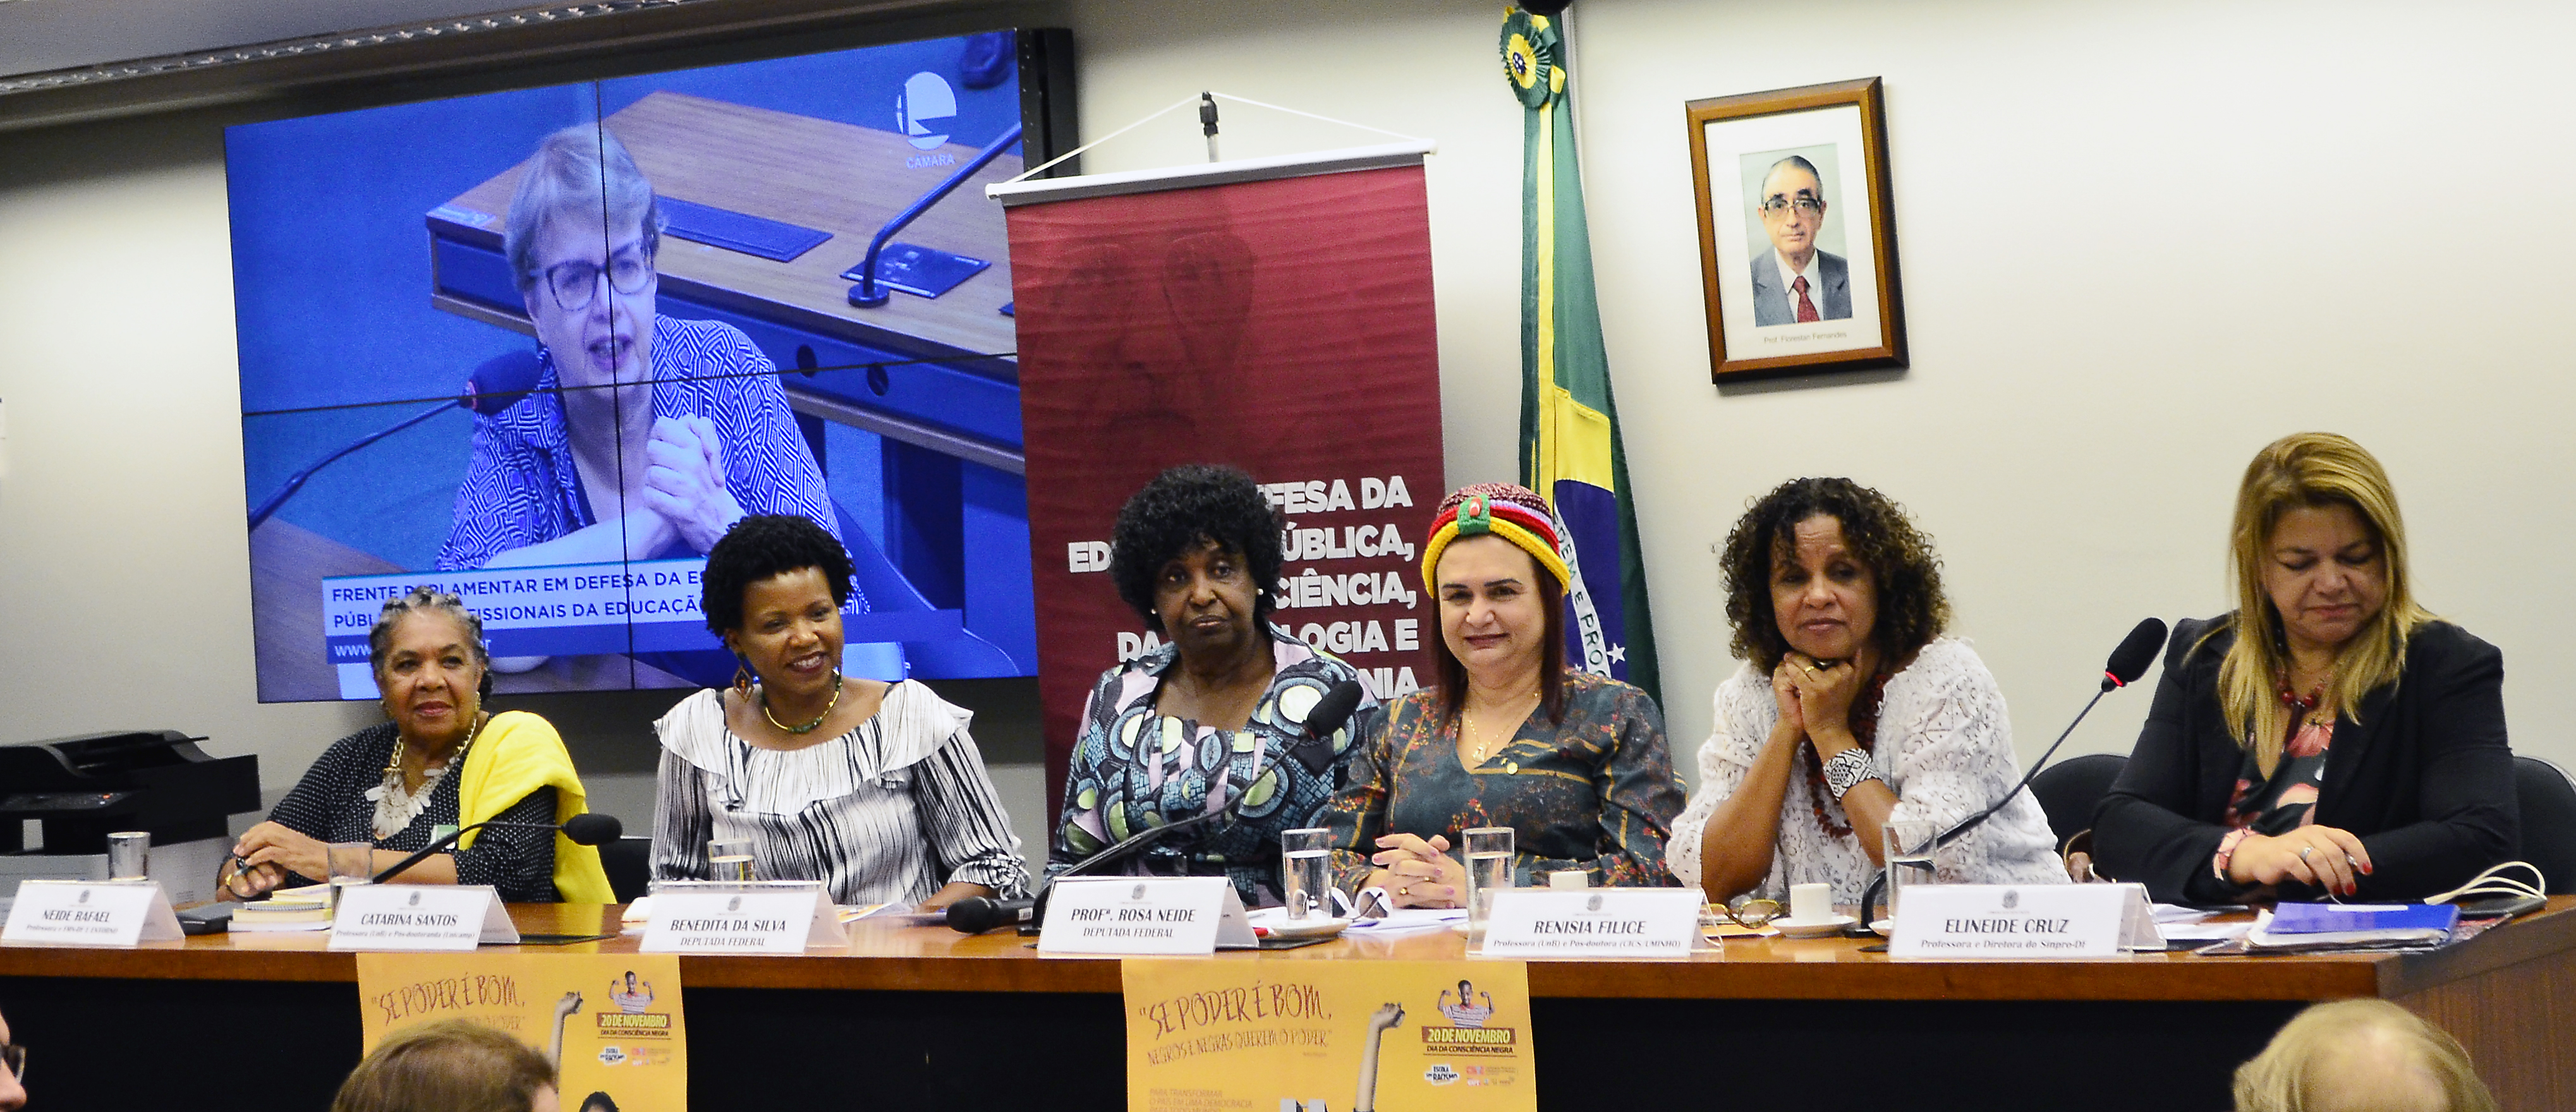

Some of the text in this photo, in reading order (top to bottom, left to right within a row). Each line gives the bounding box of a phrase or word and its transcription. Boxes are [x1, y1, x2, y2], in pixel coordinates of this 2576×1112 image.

[1256, 476, 1413, 514] FESA DA
[1281, 521, 1414, 562] ÚBLICA,
[333, 586, 398, 601] FRENTE
[544, 577, 569, 591] EM
[574, 574, 648, 589] DEFESA
[655, 572, 681, 586] DA
[1273, 568, 1417, 609] CIÊNCIA,
[334, 595, 704, 627] PÚBL ISSIONAIS DA EDUCAÇÃ
[1395, 619, 1419, 651] E
[43, 909, 110, 922] NEIDE RAFAEL
[361, 914, 458, 926] CATARINA SANTOS
[1118, 909, 1152, 921] ROSA
[1157, 909, 1196, 922] NEIDE
[670, 919, 787, 931] BENEDITA DA SILVA
[1534, 921, 1646, 934] RENISIA FILICE
[1945, 919, 2070, 933] ELINEIDE CRUZ
[1083, 928, 1174, 937] DEPUTADA FEDERAL
[681, 937, 765, 946] DEPUTADA FEDERAL
[1921, 939, 1972, 948] Professora
[1984, 940, 2023, 948] Diretora
[400, 978, 462, 1017] PODER
[462, 972, 474, 1006] É
[475, 975, 526, 1008] BOM,
[1175, 987, 1253, 1031] PODER
[1252, 980, 1268, 1018] É
[1269, 983, 1332, 1020] BOM,
[601, 1014, 667, 1028] 20 DE NOVEMBRO
[1427, 1028, 1511, 1044] 20 DE NOVEMBRO
[1147, 1043, 1188, 1067] NEGROS
[1196, 1032, 1233, 1055] NEGRAS
[1235, 1030, 1277, 1049] QUEREM
[1449, 1044, 1490, 1053] CONSCIÊNCIA
